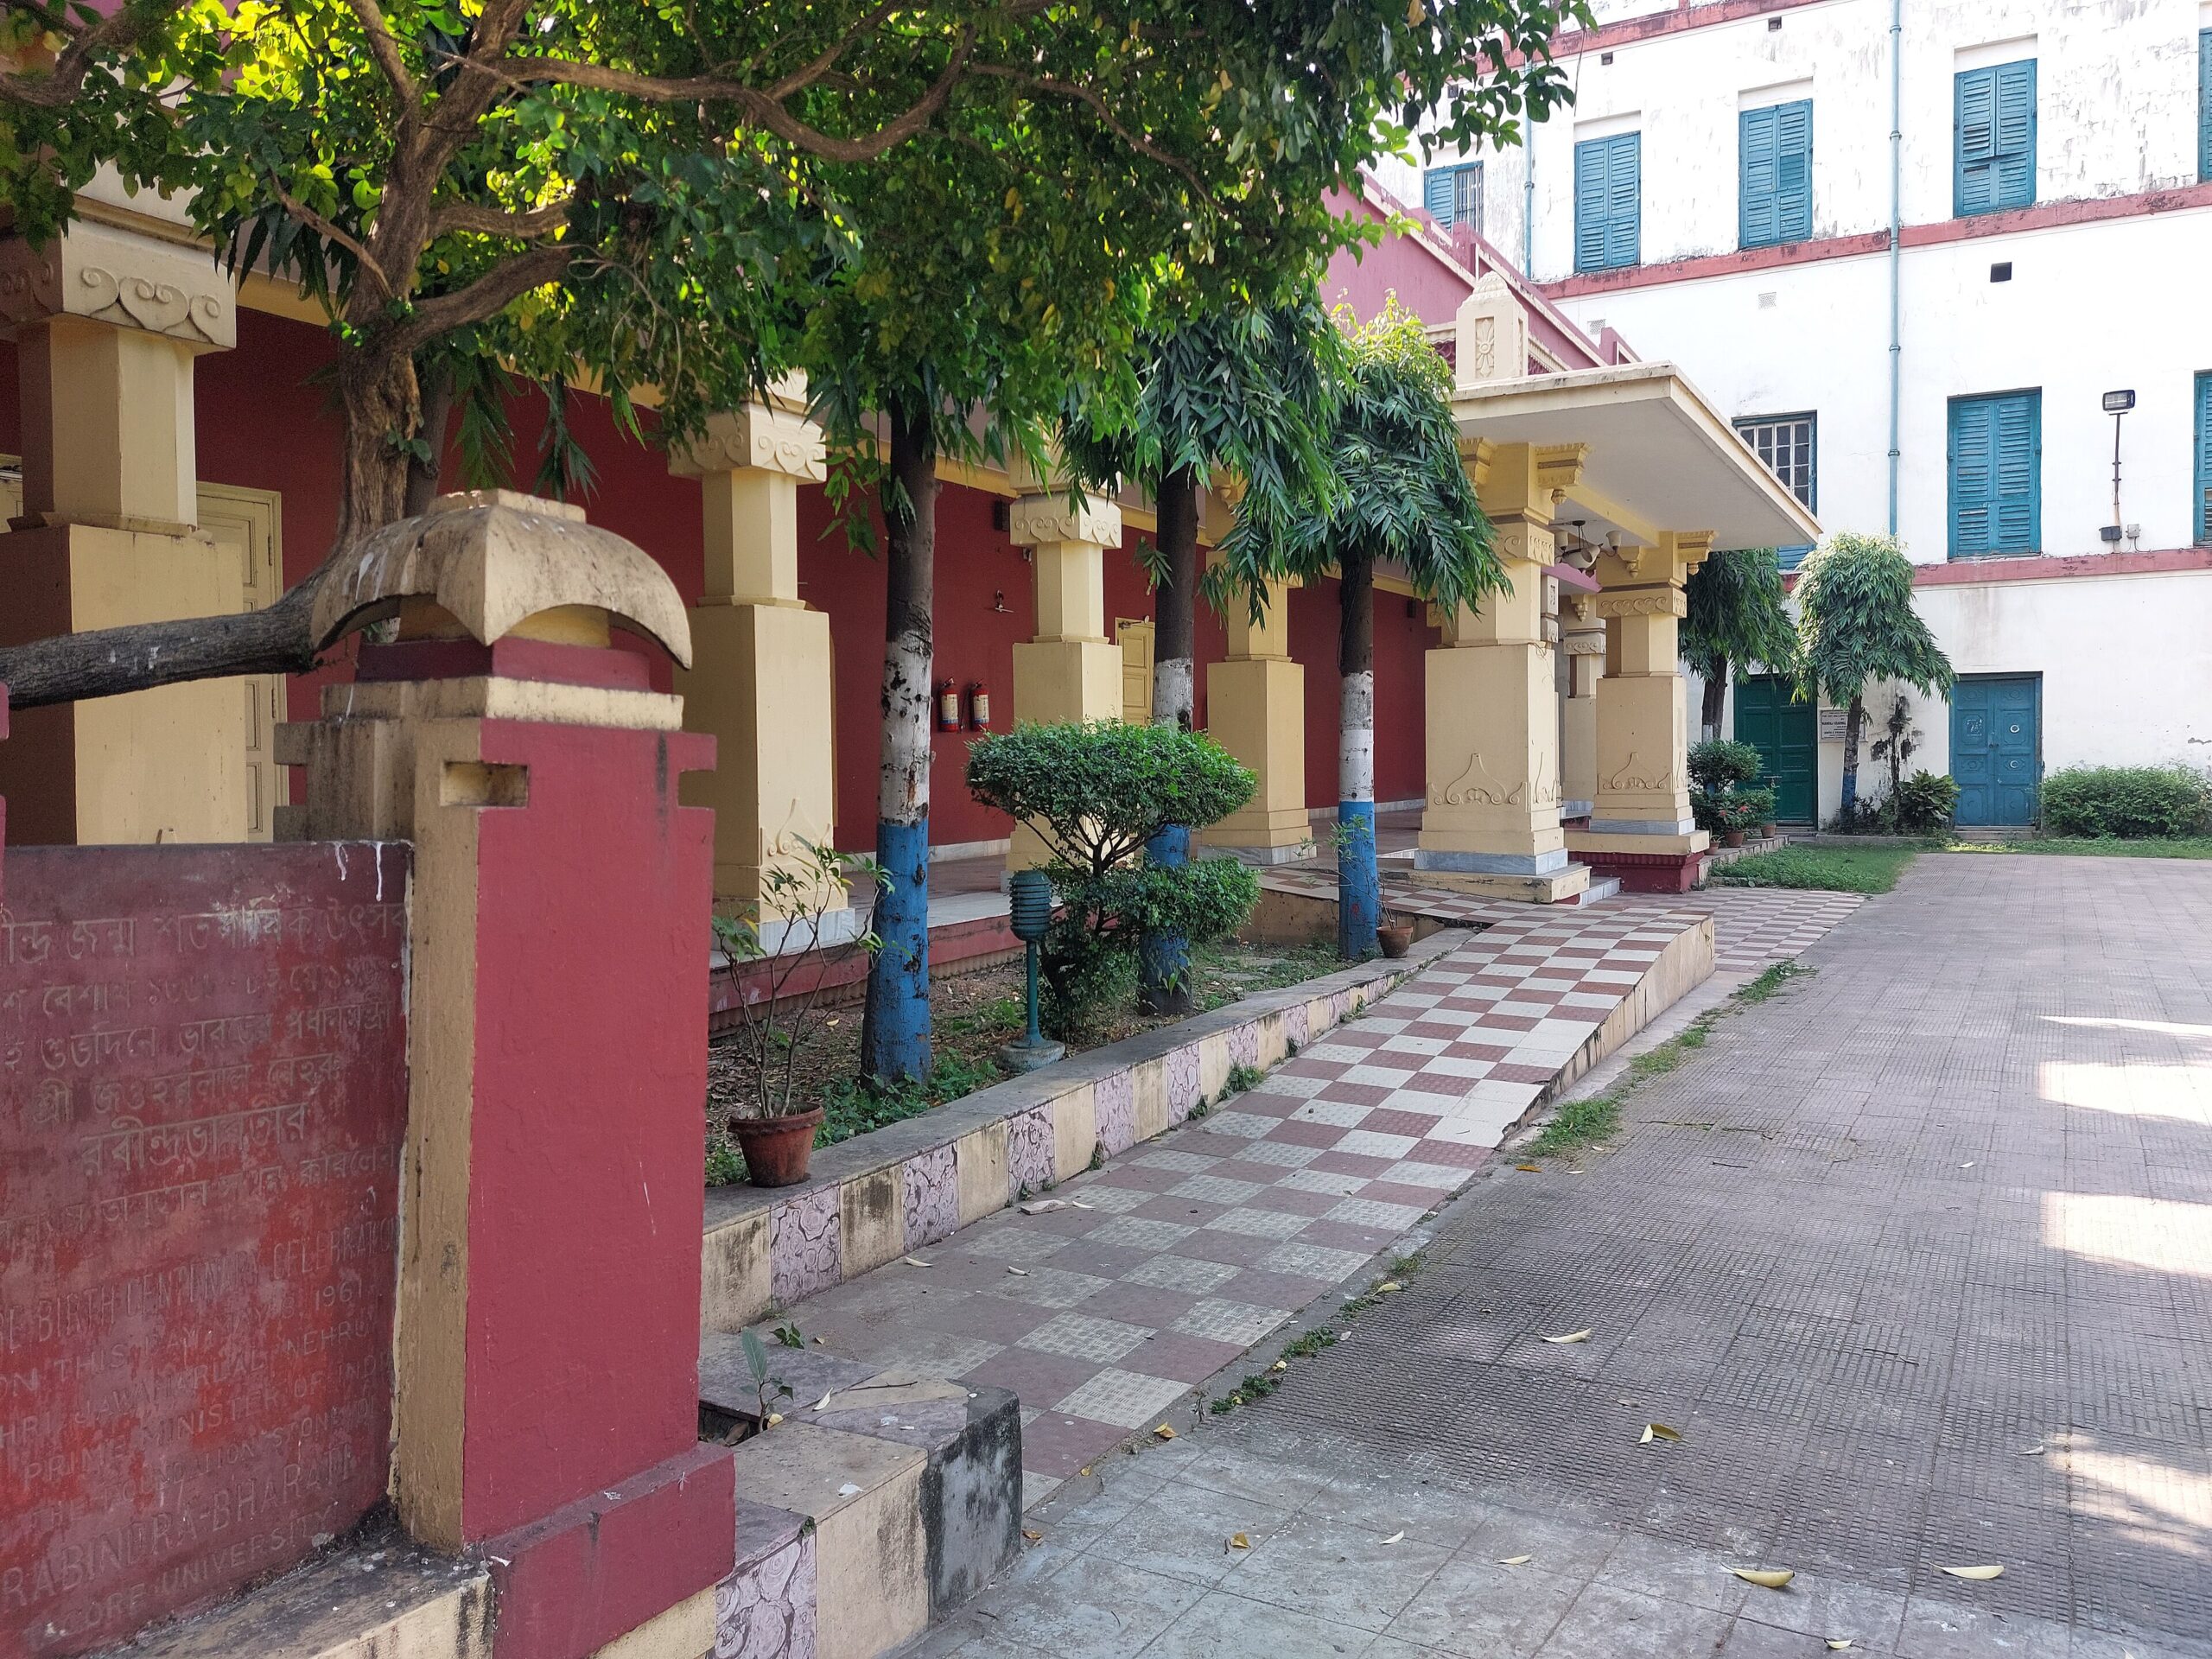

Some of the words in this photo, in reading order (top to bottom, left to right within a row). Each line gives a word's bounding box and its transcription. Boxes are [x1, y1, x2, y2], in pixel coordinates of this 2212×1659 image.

[67, 917, 137, 961] জন্ম
[39, 1285, 115, 1342] BIRTH
[54, 1343, 128, 1383] THIS
[0, 1410, 50, 1448] HRI
[23, 1434, 126, 1493] PRIME
[162, 1497, 337, 1595] UNIVERSITY
